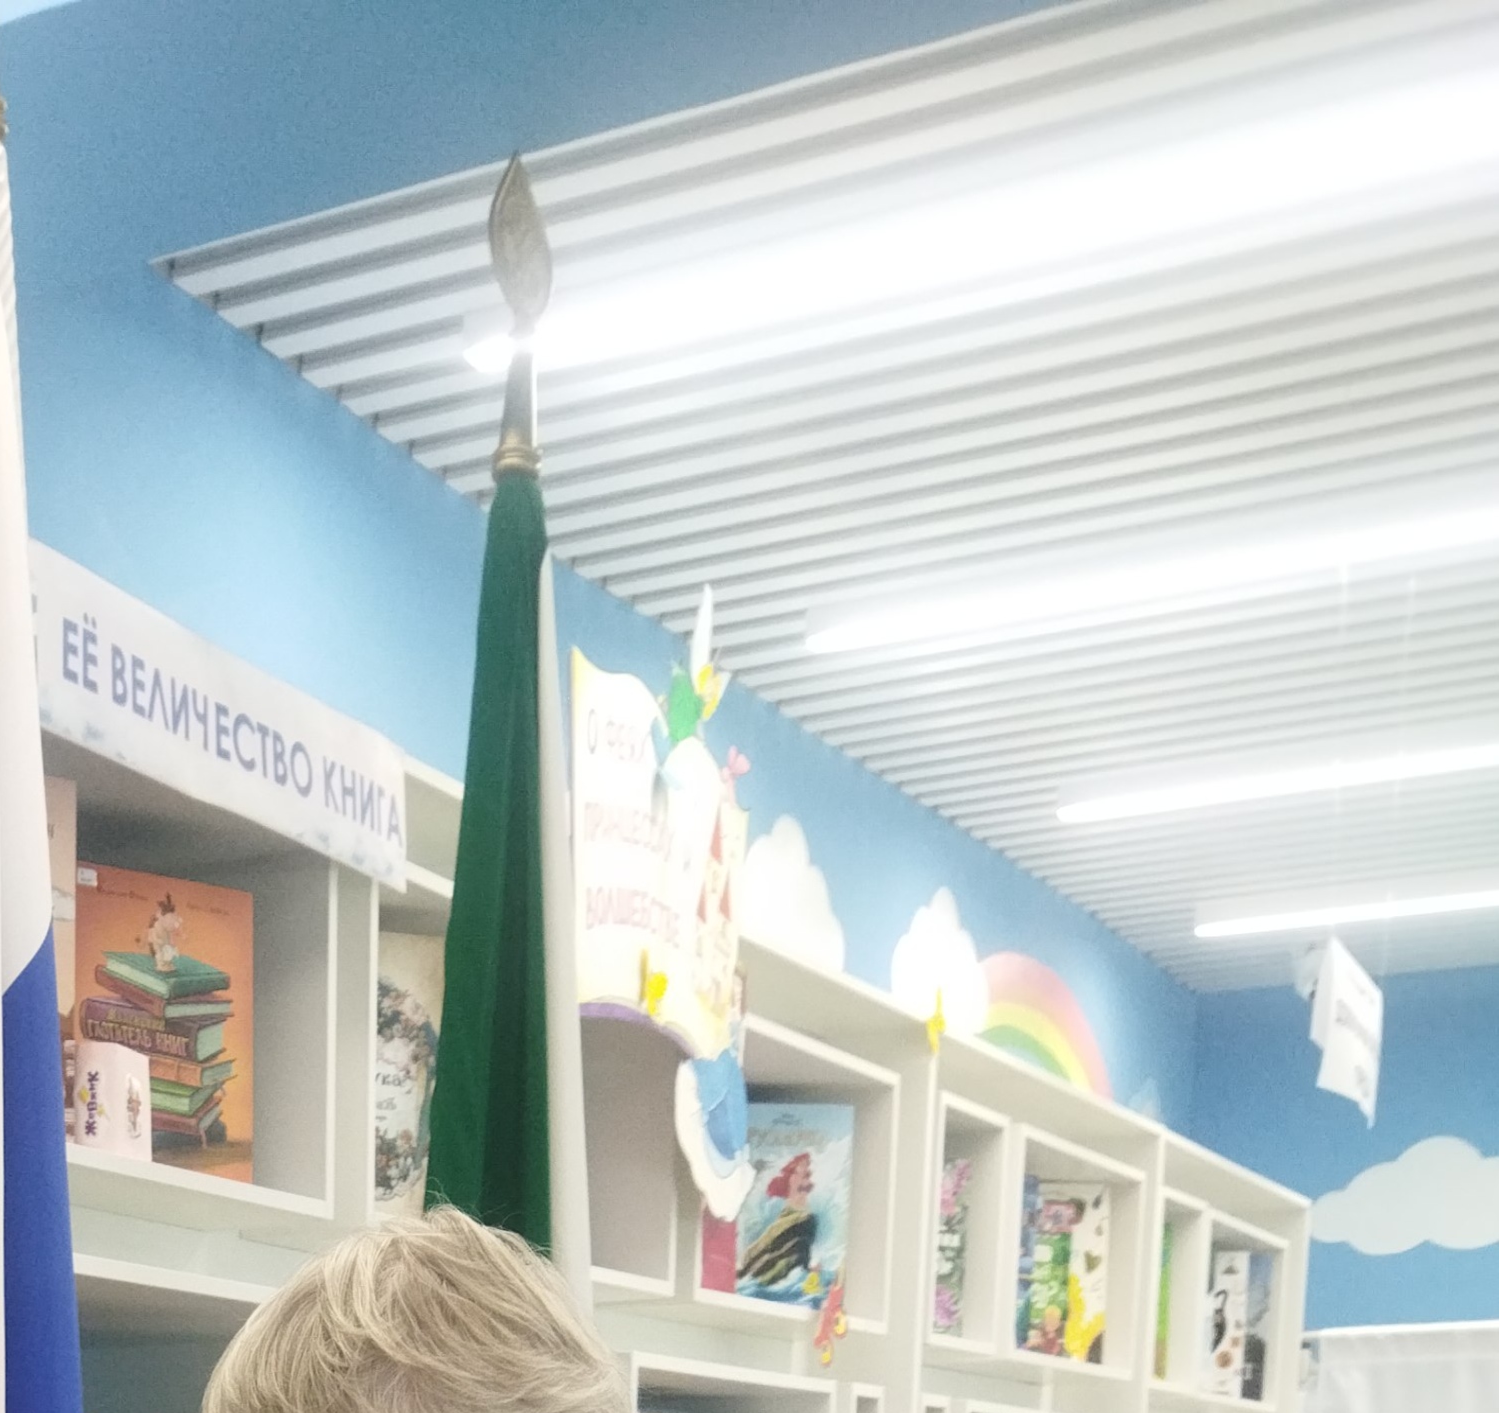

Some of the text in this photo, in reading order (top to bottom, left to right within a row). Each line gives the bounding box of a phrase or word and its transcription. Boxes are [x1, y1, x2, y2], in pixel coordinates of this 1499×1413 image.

[61, 612, 403, 848] ЕЁ ВЕЛИЧЕСТВО КНИГА
